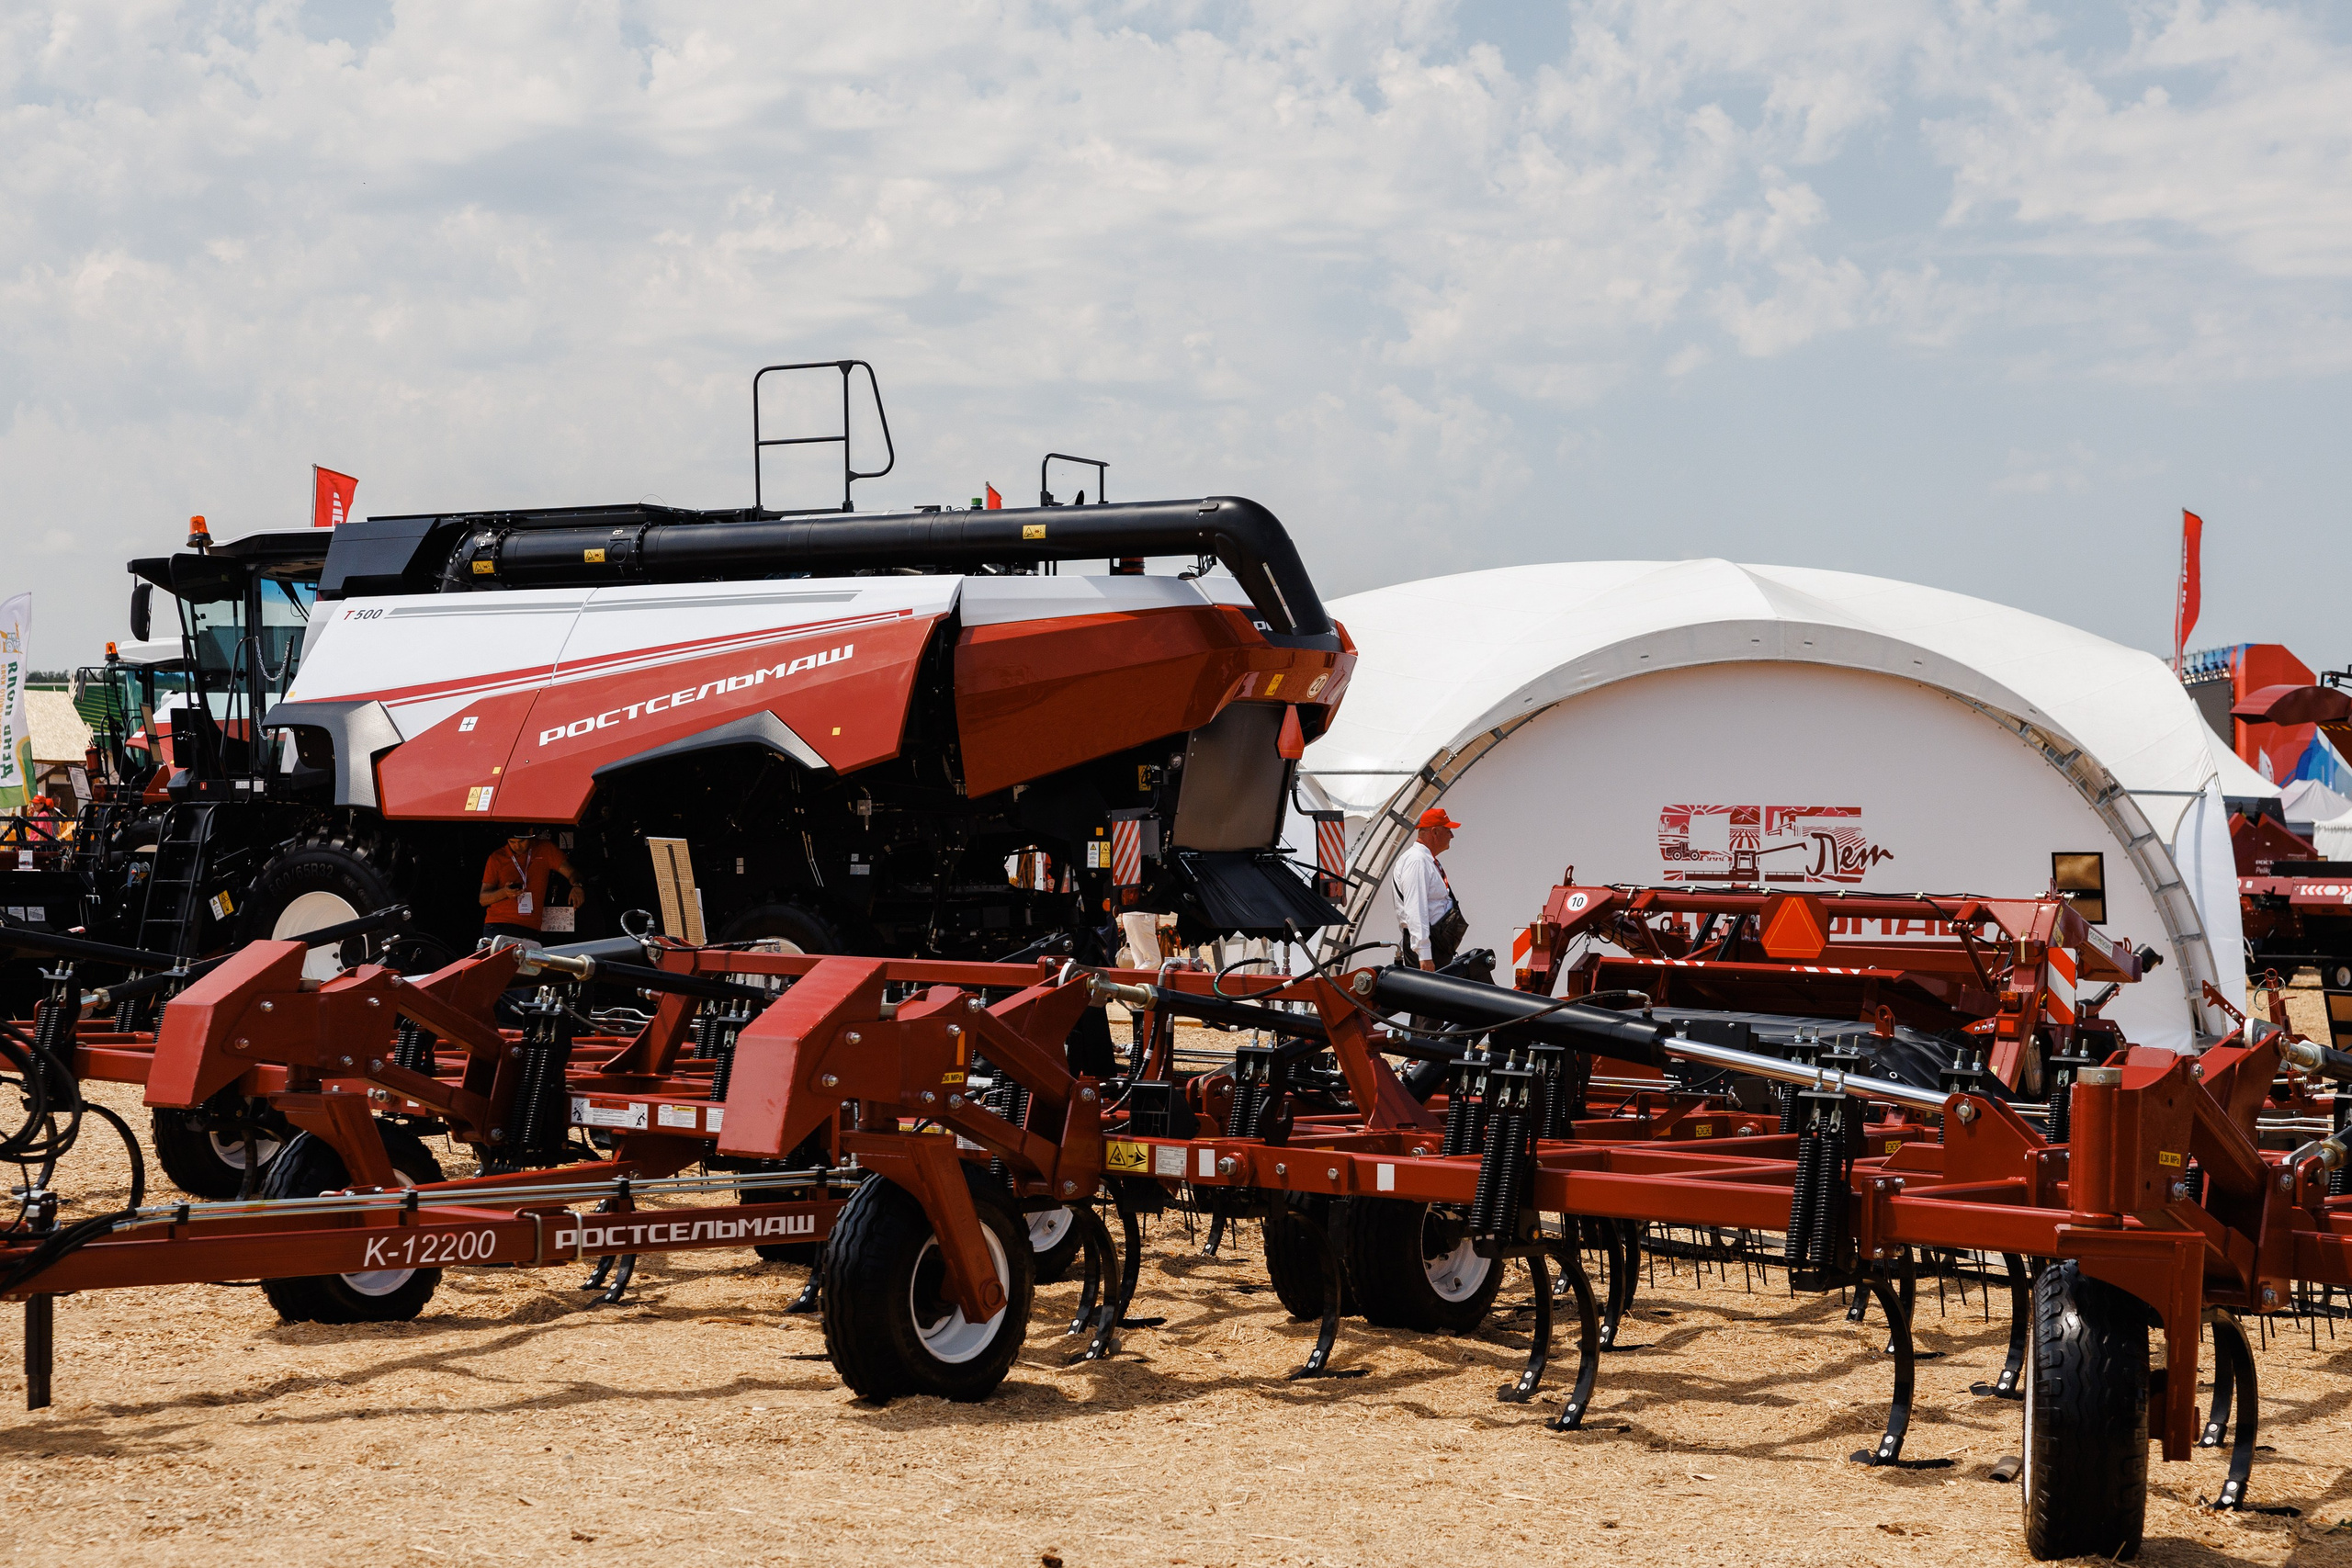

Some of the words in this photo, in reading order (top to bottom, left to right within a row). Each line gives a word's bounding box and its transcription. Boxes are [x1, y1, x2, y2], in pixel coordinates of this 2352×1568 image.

[344, 610, 356, 621] T
[354, 608, 384, 620] 500
[538, 644, 854, 747] РОСТСЕЛЬМАШ
[1311, 678, 1326, 693] 20
[1572, 897, 1585, 908] 10
[555, 1214, 815, 1250] РОСТСЕЛЬМАШ
[363, 1229, 496, 1268] K-12200
